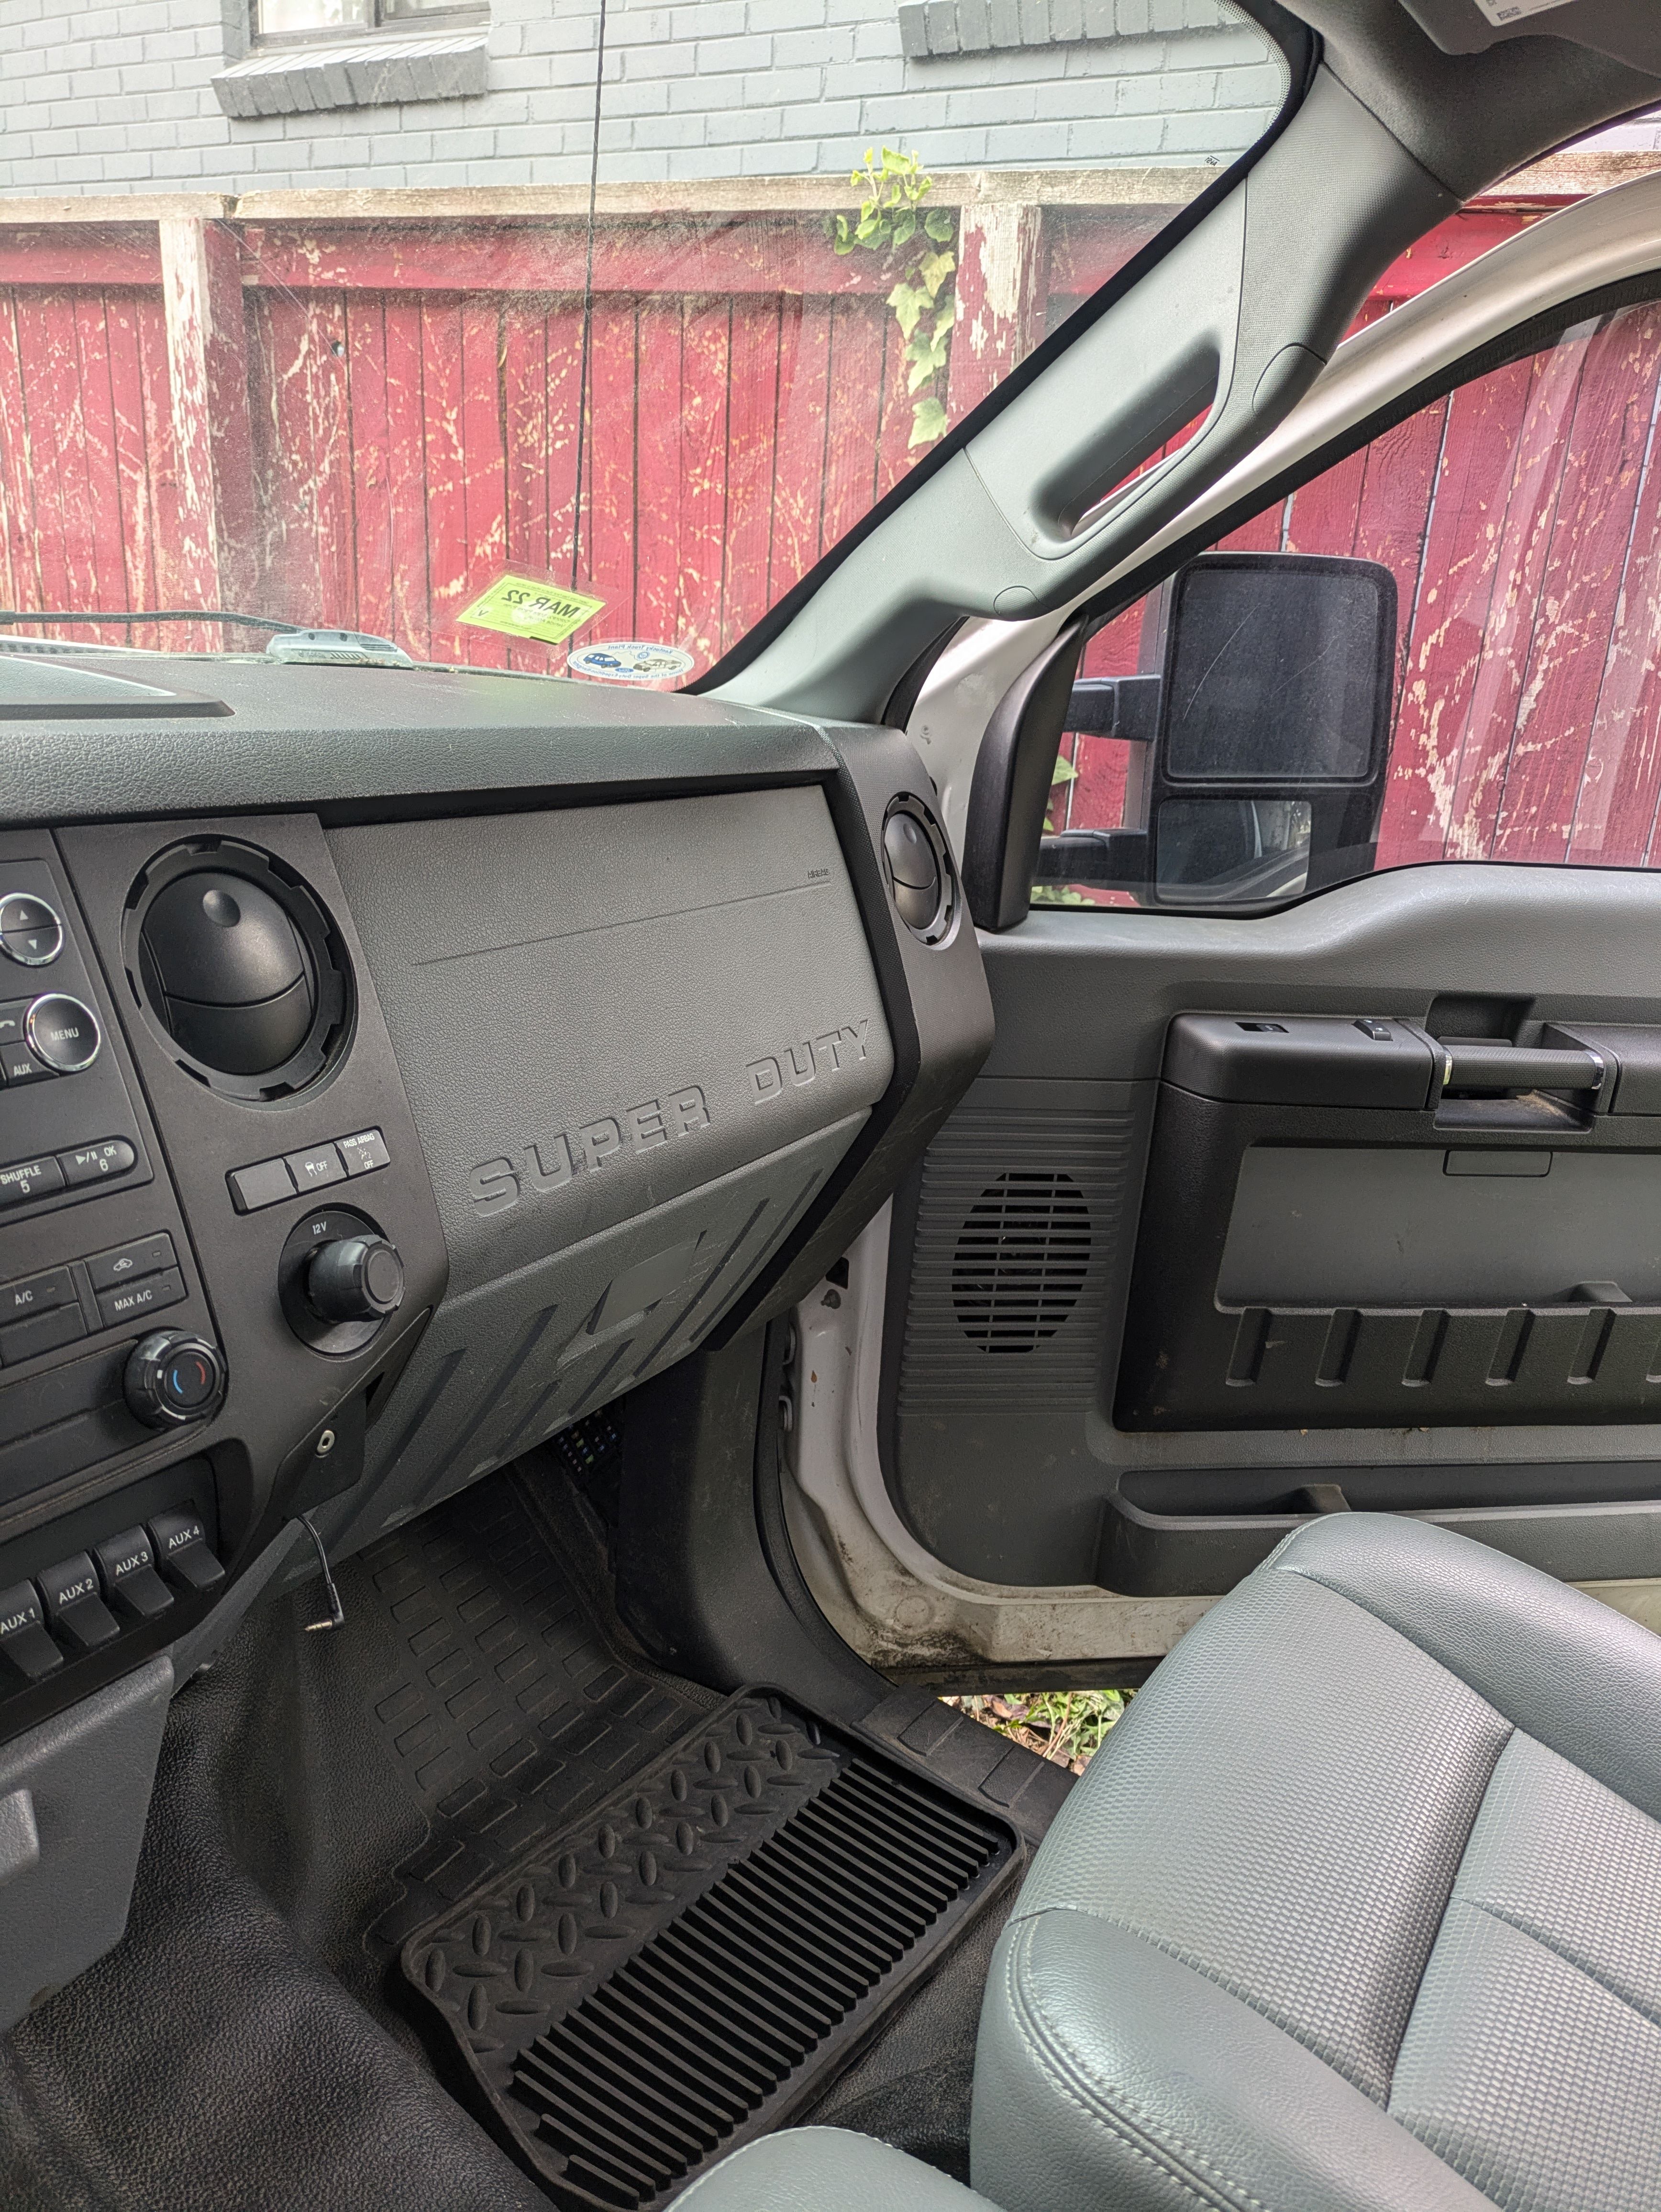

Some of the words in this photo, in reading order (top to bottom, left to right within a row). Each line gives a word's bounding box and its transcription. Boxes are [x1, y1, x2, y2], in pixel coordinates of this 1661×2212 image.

[50, 1027, 79, 1041] MENU
[13, 1063, 32, 1076] AUX
[468, 1084, 710, 1217] SUPER
[745, 1019, 869, 1105] DUTY
[343, 1139, 357, 1148] PASS
[357, 1133, 375, 1144] AIRBAG
[104, 1145, 117, 1157] OK
[99, 1159, 109, 1172] 6
[316, 1161, 328, 1172] OFF
[364, 1160, 374, 1169] OFF
[0, 1165, 42, 1185] SHUFFLE
[20, 1180, 31, 1193] 5
[312, 1221, 326, 1235] 12V
[15, 1291, 33, 1305] A/C
[114, 1296, 135, 1311] MAX
[137, 1290, 153, 1304] A/C
[169, 1529, 192, 1549] AUX
[192, 1526, 199, 1536] 4
[115, 1557, 140, 1576] AUX
[141, 1551, 149, 1562] 3
[59, 1584, 85, 1605] AUX
[86, 1579, 94, 1590] 2
[0, 1611, 27, 1635] AUX
[29, 1608, 35, 1618] 1
